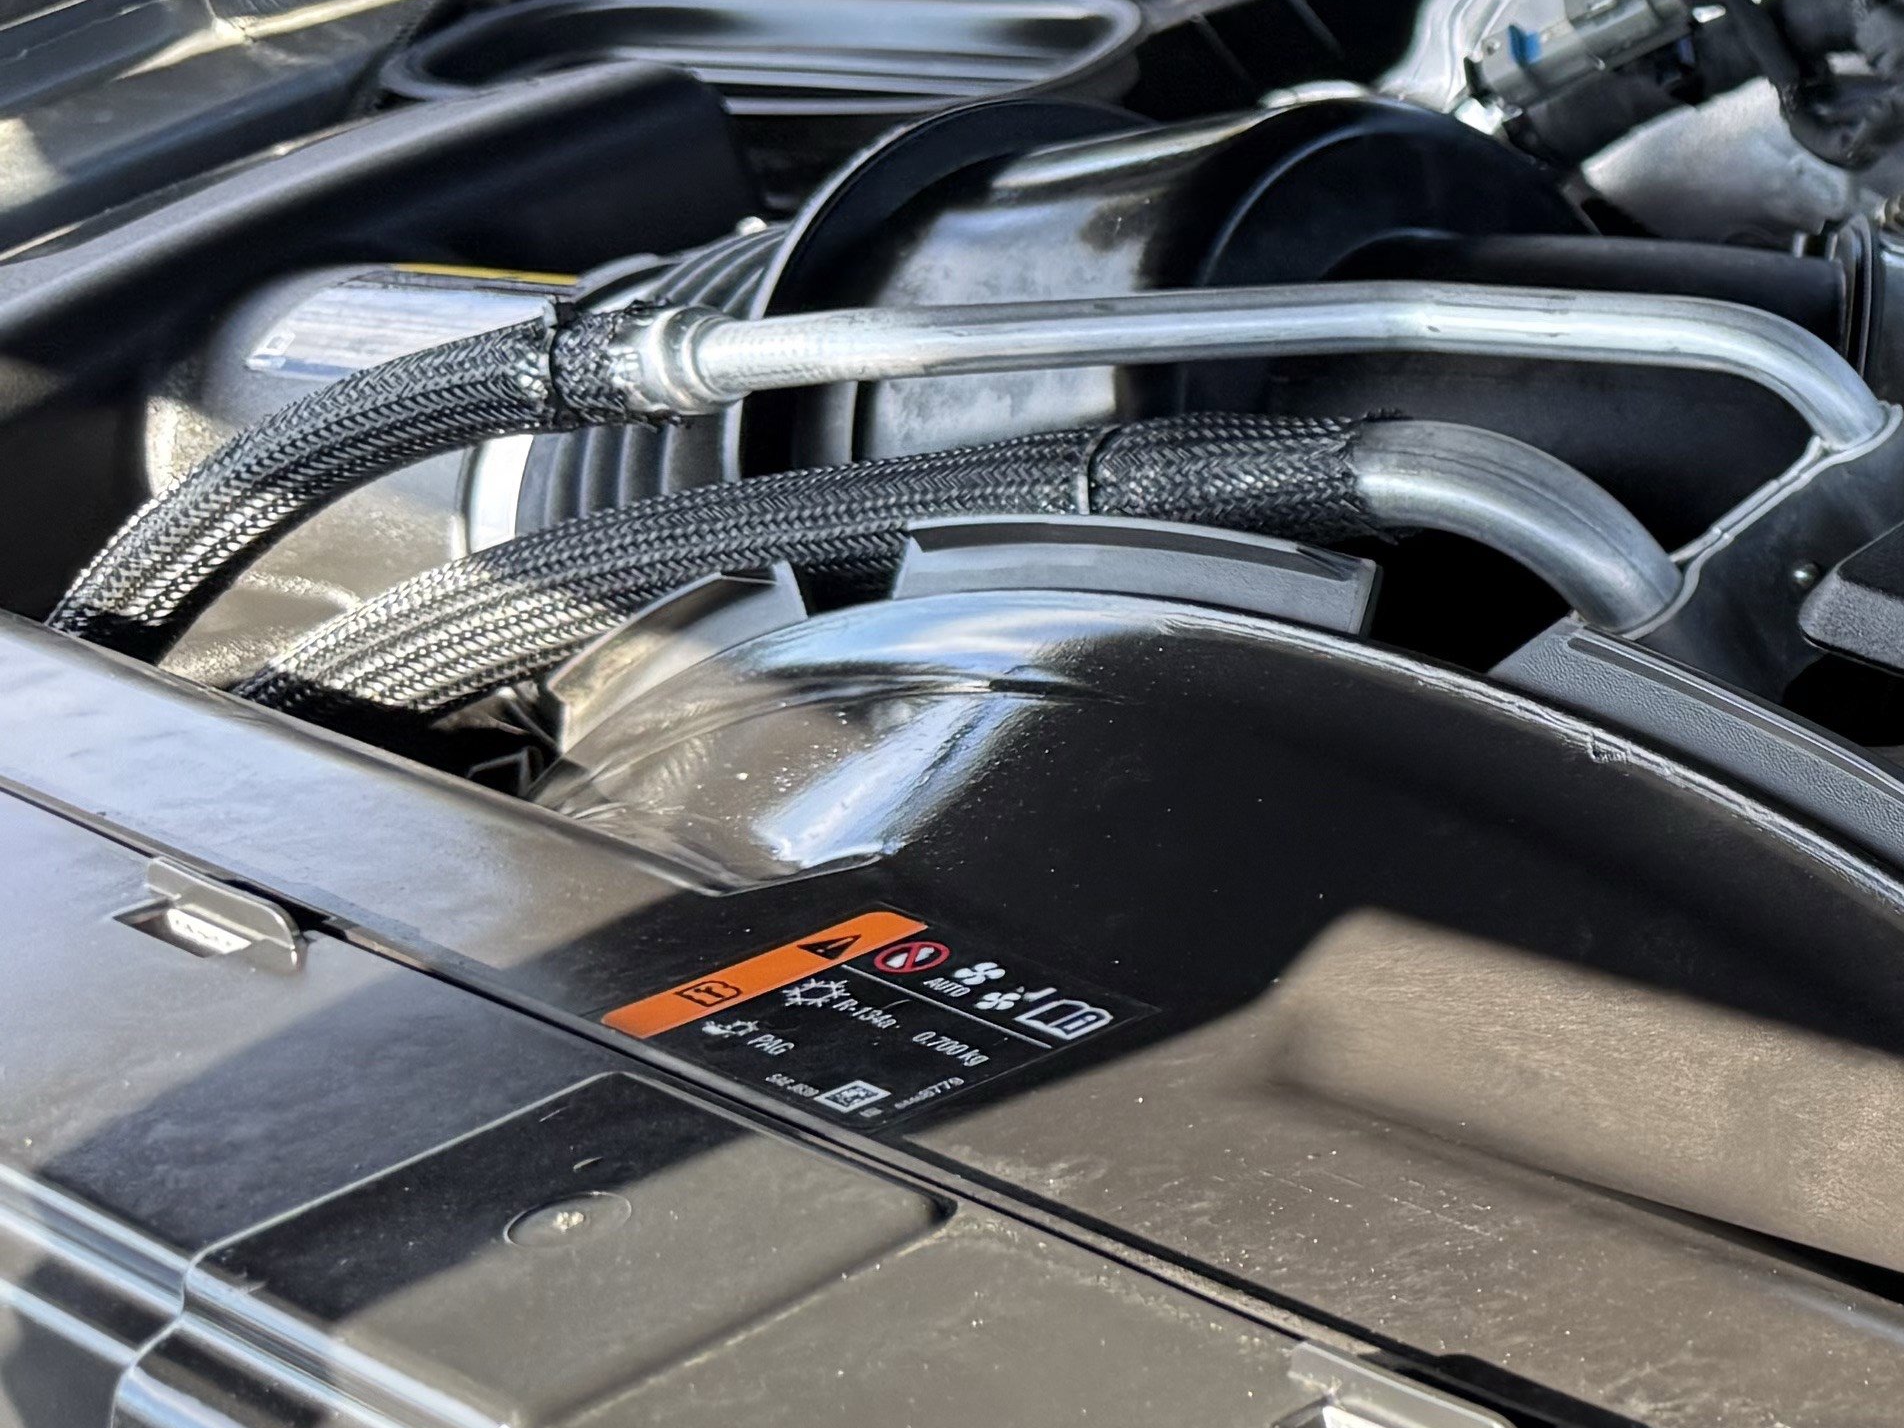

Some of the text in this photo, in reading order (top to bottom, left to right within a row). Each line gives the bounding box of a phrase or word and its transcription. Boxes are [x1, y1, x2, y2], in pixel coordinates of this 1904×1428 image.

[923, 977, 971, 998] AUTO
[832, 998, 989, 1067] R-134a 0.700 kg
[747, 1033, 795, 1055] PAG
